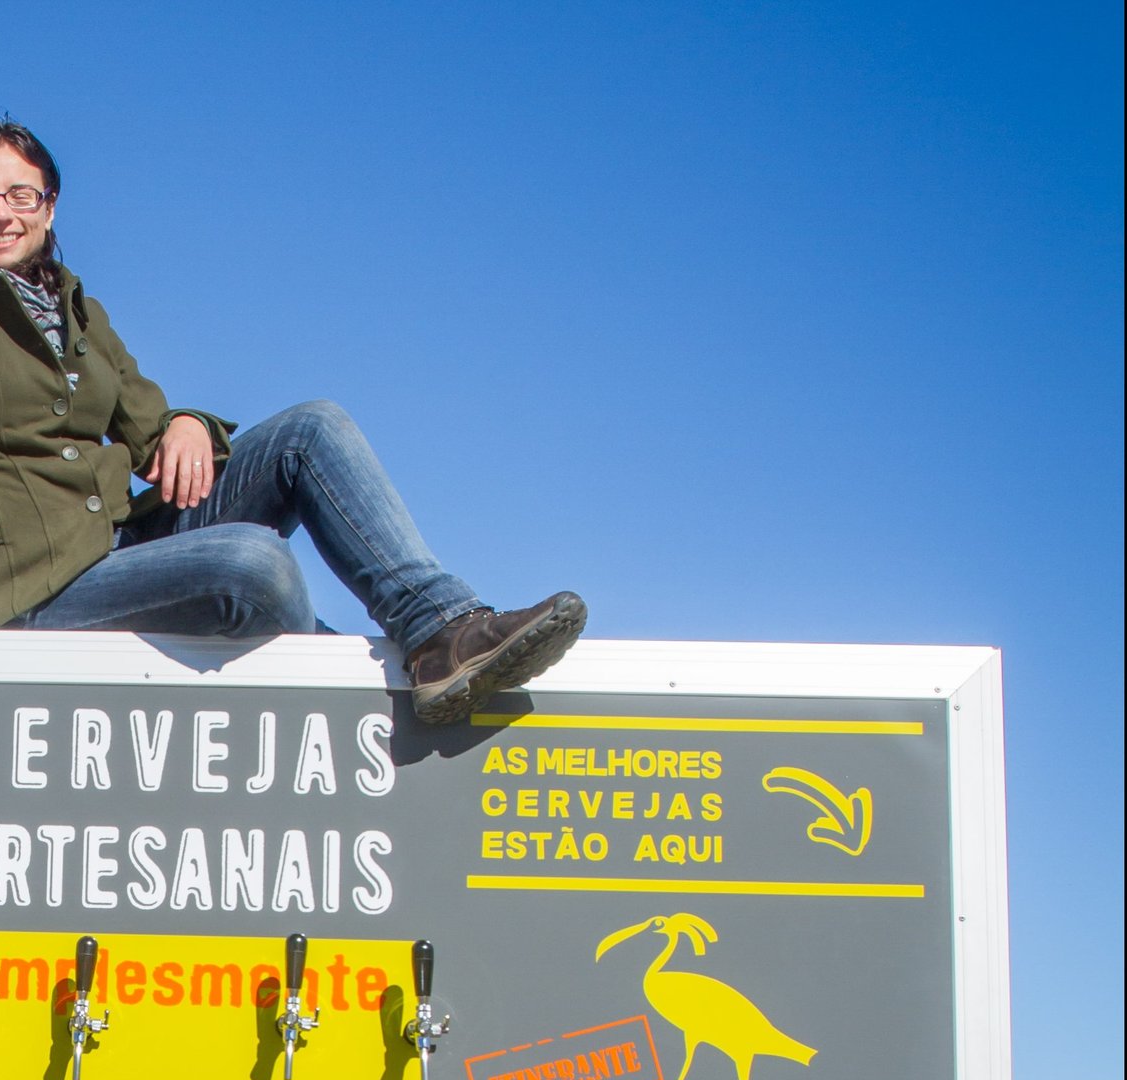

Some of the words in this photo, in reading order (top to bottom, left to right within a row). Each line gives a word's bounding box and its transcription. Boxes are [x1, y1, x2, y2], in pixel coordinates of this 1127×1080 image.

[482, 746, 528, 775] AS
[536, 747, 723, 779] MELHORES
[481, 788, 723, 822] CERVEJAS
[480, 826, 609, 862] ESTÃO
[633, 834, 723, 864] AQUI
